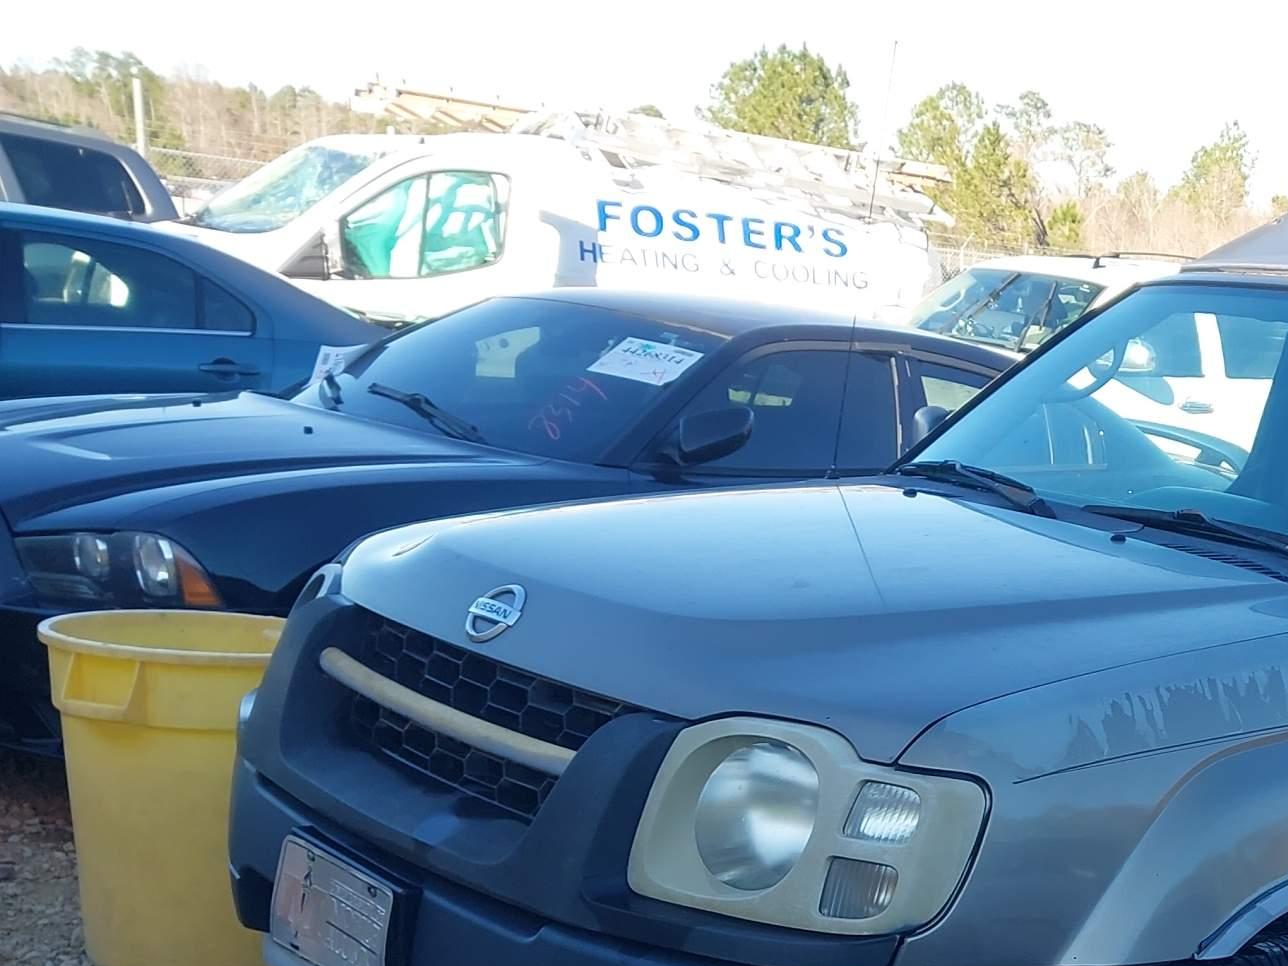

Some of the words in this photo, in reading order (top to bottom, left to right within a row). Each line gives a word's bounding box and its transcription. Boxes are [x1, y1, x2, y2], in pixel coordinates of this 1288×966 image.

[597, 199, 849, 258] FOSTER'S
[579, 240, 700, 272] HEATING
[720, 259, 737, 277] &
[754, 259, 869, 290] COOLING
